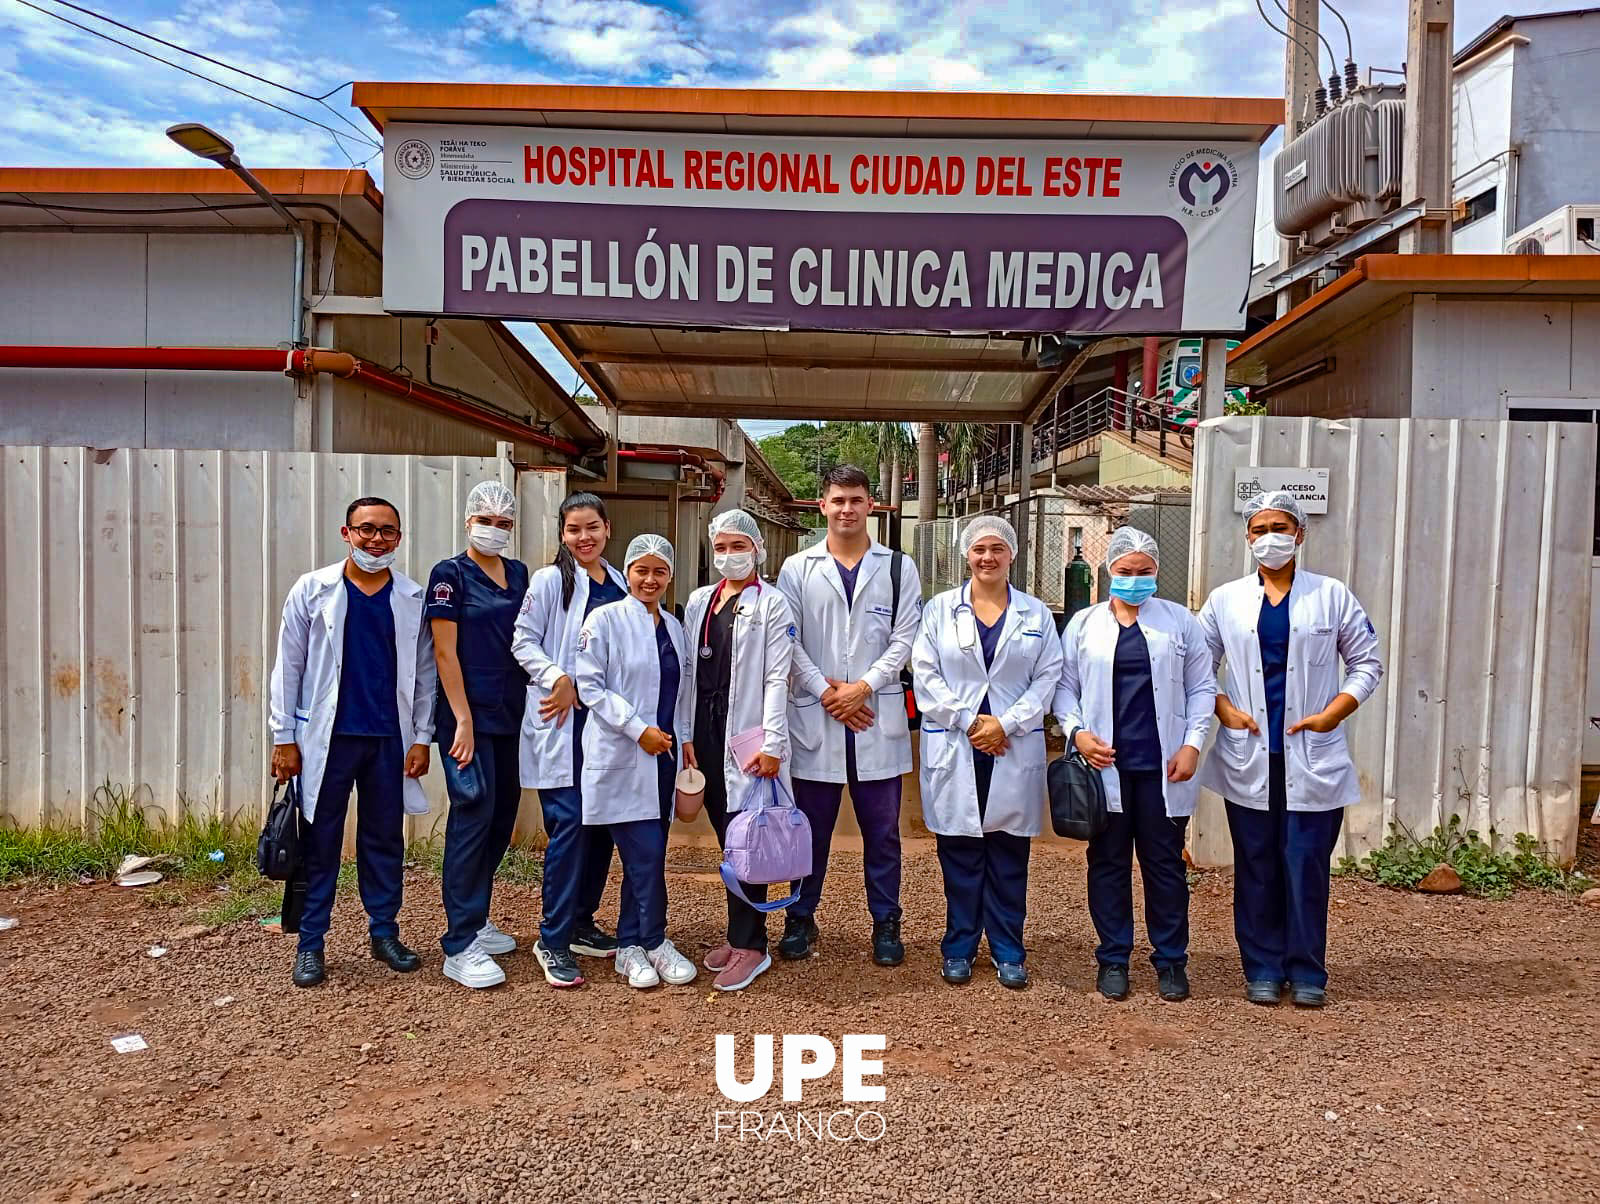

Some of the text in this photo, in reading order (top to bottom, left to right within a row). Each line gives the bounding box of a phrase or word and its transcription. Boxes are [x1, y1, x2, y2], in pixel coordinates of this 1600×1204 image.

[440, 169, 464, 177] SALUD
[524, 145, 1123, 198] HOSPITAL REGIONAL CIUDAD DEL ESTE
[1168, 157, 1186, 188] SERVICIO
[1185, 150, 1195, 160] DE
[1195, 147, 1228, 162] MEDICINA
[462, 227, 1165, 310] PABELLÓN DE CLINICA MEDICA
